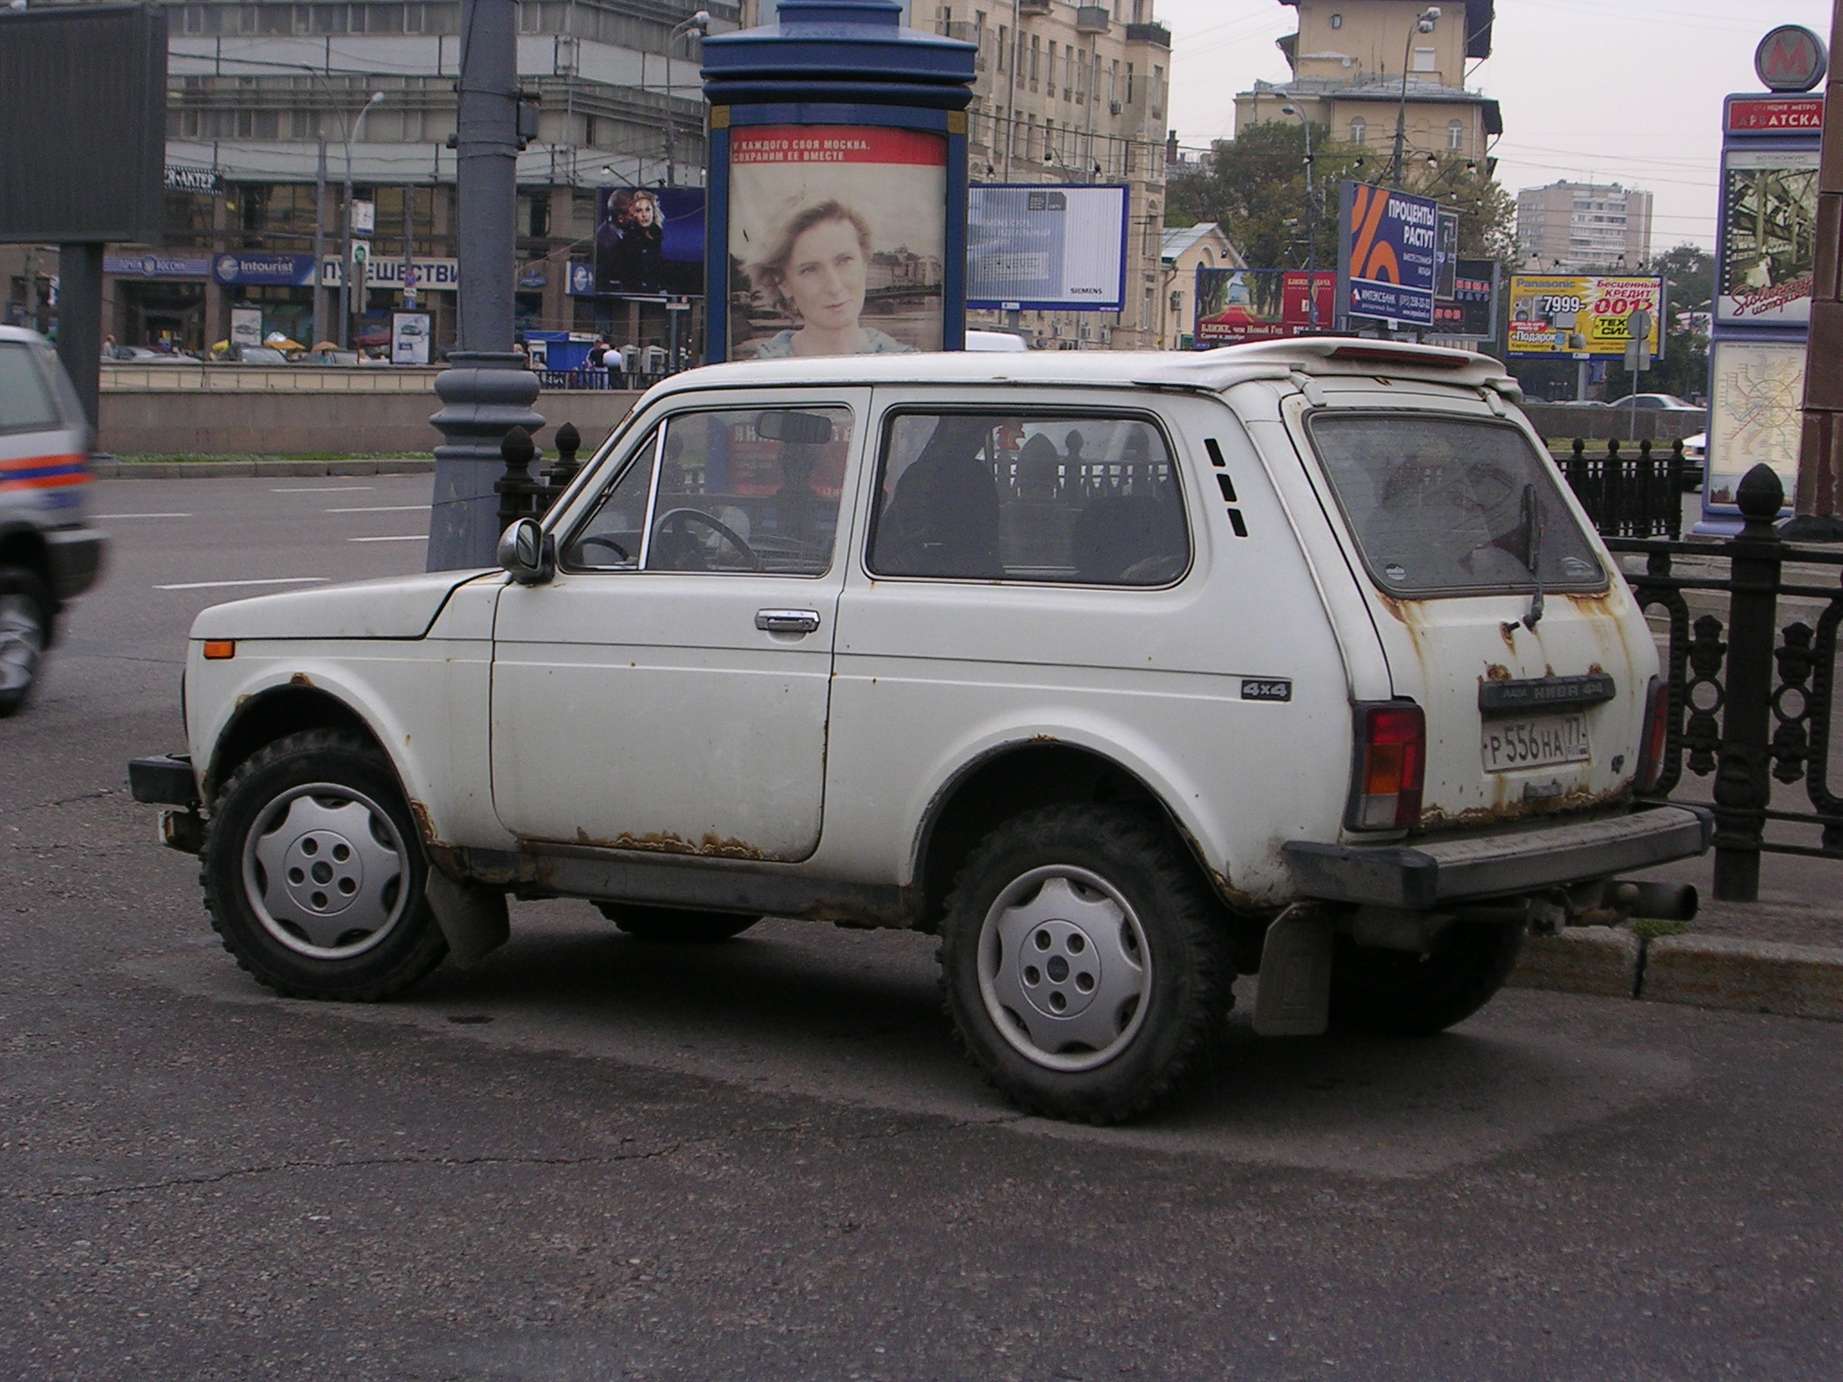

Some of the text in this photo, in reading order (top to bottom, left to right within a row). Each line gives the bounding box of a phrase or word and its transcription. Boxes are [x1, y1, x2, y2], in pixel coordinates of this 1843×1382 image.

[1737, 113, 1820, 126] АРБАТСКА
[742, 141, 788, 150] КАЖДОГО
[792, 140, 820, 149] СВОЯ
[823, 140, 871, 150] МОСКВА.
[732, 151, 784, 162] СОХРАНИМ
[803, 151, 845, 161] ВМЕСТЕ
[1388, 198, 1434, 226] ПРОЦЕНТЫ
[1403, 225, 1434, 249] РАСТУТ
[240, 260, 295, 273] Intourist
[1516, 278, 1574, 289] Panasonic
[1597, 280, 1662, 289] Бесценный
[1070, 287, 1103, 295] SIEMENS
[1605, 290, 1652, 298] КРЕДИТ
[1243, 682, 1288, 696] 4x4
[1565, 717, 1581, 745] 77
